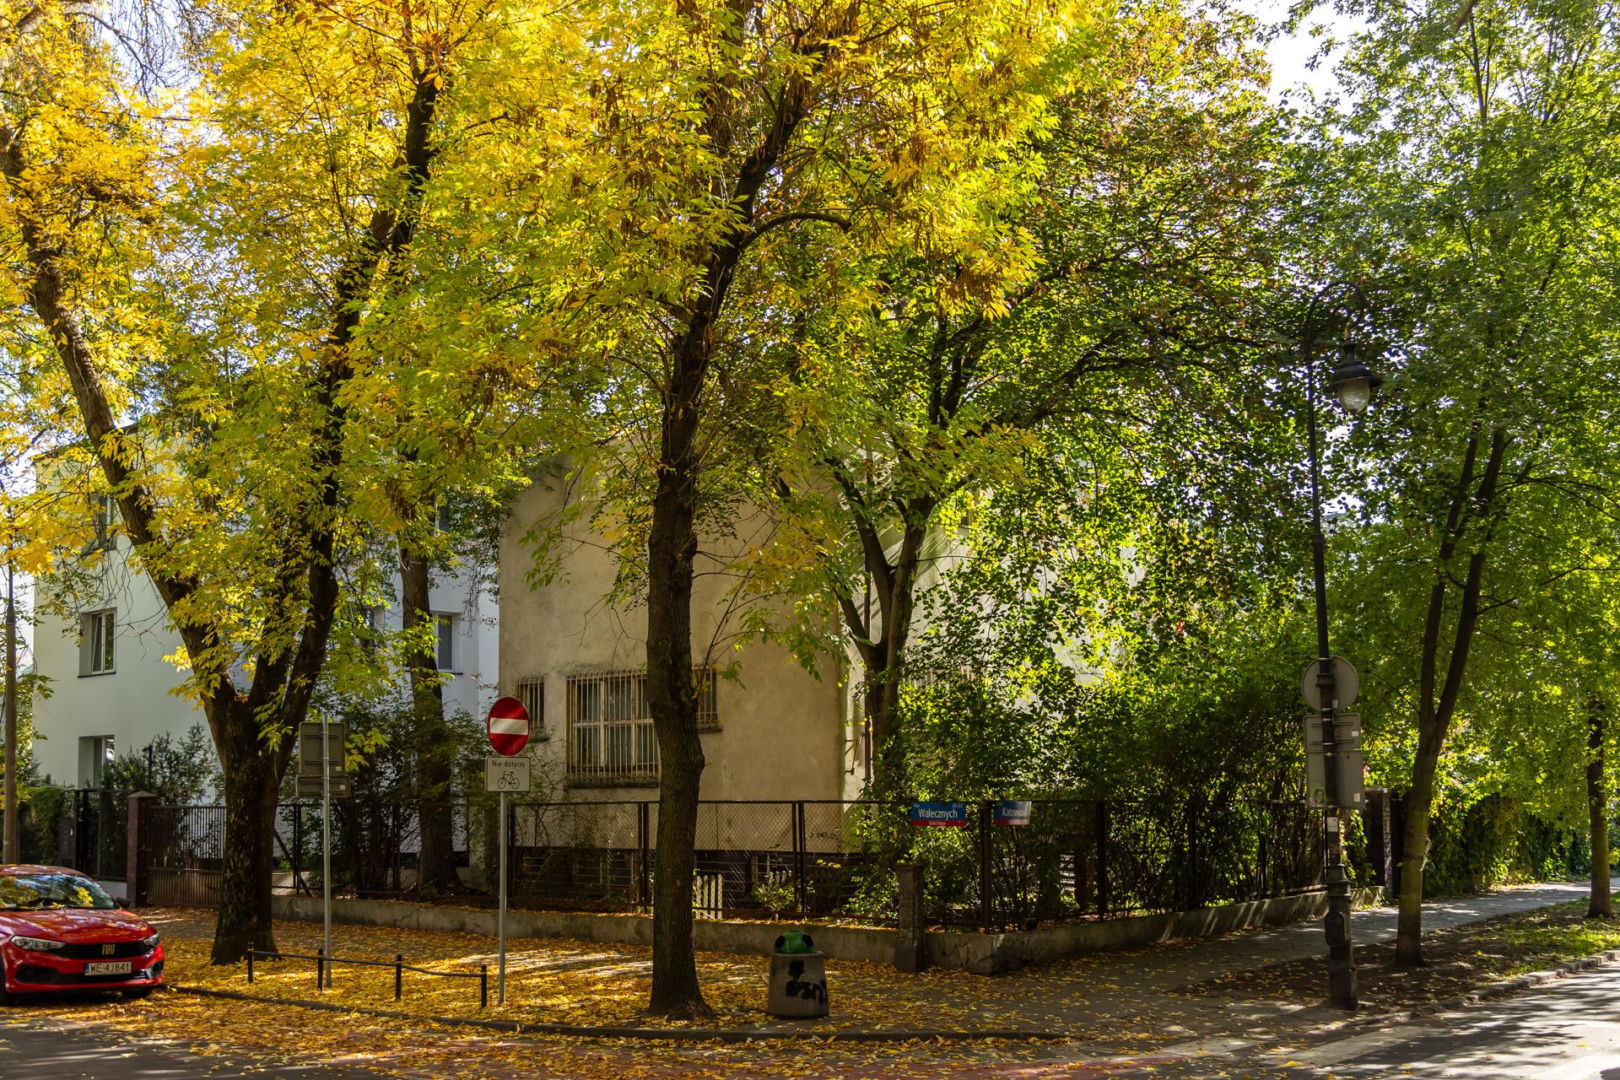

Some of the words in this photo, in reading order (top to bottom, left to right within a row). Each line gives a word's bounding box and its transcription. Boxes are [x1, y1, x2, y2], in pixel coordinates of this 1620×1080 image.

[503, 760, 526, 768] dotyczy
[918, 808, 958, 820] Walecznych
[101, 944, 116, 956] FIAT
[91, 963, 101, 973] WE
